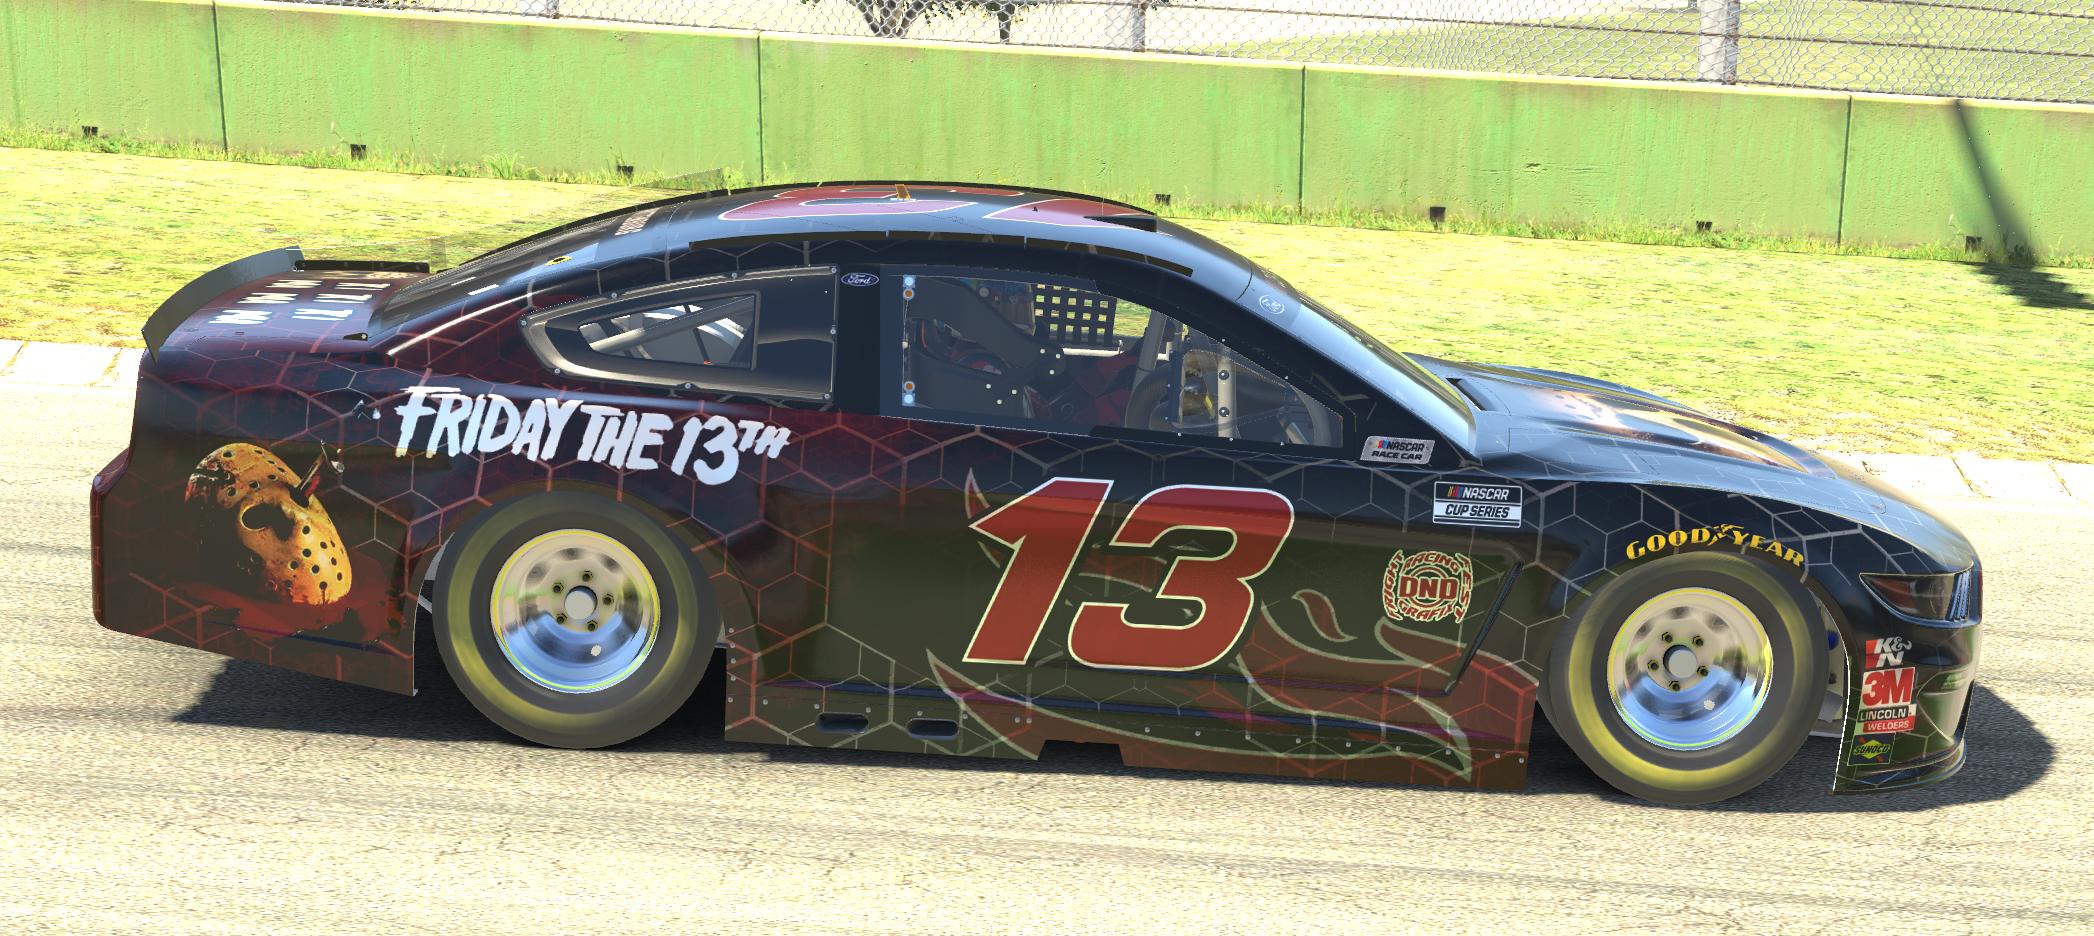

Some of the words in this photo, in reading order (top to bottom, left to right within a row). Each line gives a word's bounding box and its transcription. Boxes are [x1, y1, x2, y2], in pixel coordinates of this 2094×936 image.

[394, 386, 584, 460] FRIDAY
[577, 404, 674, 470] THE
[1371, 450, 1399, 459] RACE
[1400, 452, 1423, 460] CAR
[1387, 440, 1425, 451] NASCAR
[1462, 487, 1510, 501] NASCAR
[1445, 504, 1470, 516] CUP
[1469, 505, 1510, 518] SERIES
[1400, 551, 1461, 576] RACING
[962, 476, 1295, 671] 13
[1382, 549, 1404, 621] FRIGHT
[1398, 575, 1460, 600] DND
[1455, 553, 1473, 623] FEST
[1862, 669, 1914, 706] 3M
[1859, 709, 1907, 721] LINCOLN
[1867, 720, 1910, 730] WELDERS
[1854, 745, 1890, 754] SUNOCO
